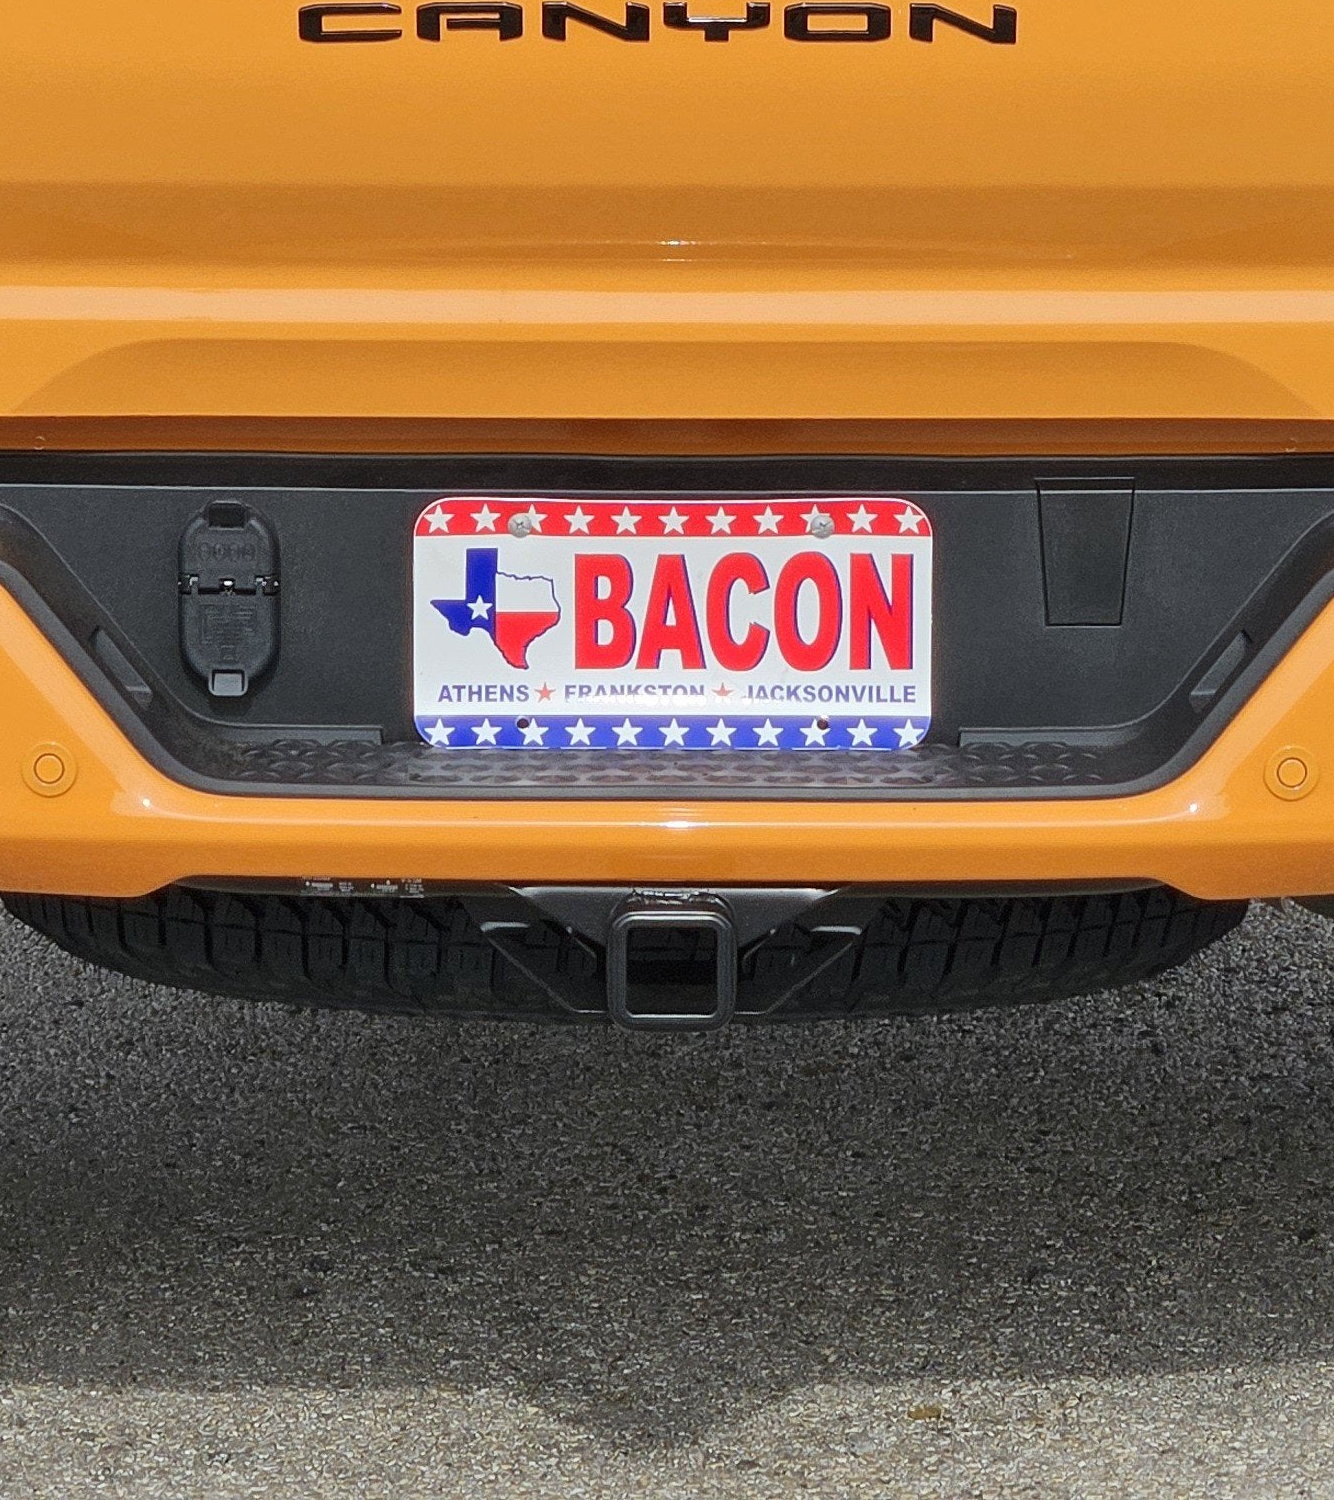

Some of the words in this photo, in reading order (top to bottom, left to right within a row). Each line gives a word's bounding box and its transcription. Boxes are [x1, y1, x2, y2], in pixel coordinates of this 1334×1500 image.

[298, 1, 1018, 46] CANYON
[573, 551, 914, 671] BACON
[437, 684, 530, 703] ATHENS
[564, 684, 705, 703] FRANKSTON
[742, 684, 917, 703] JACKSONVILLE
